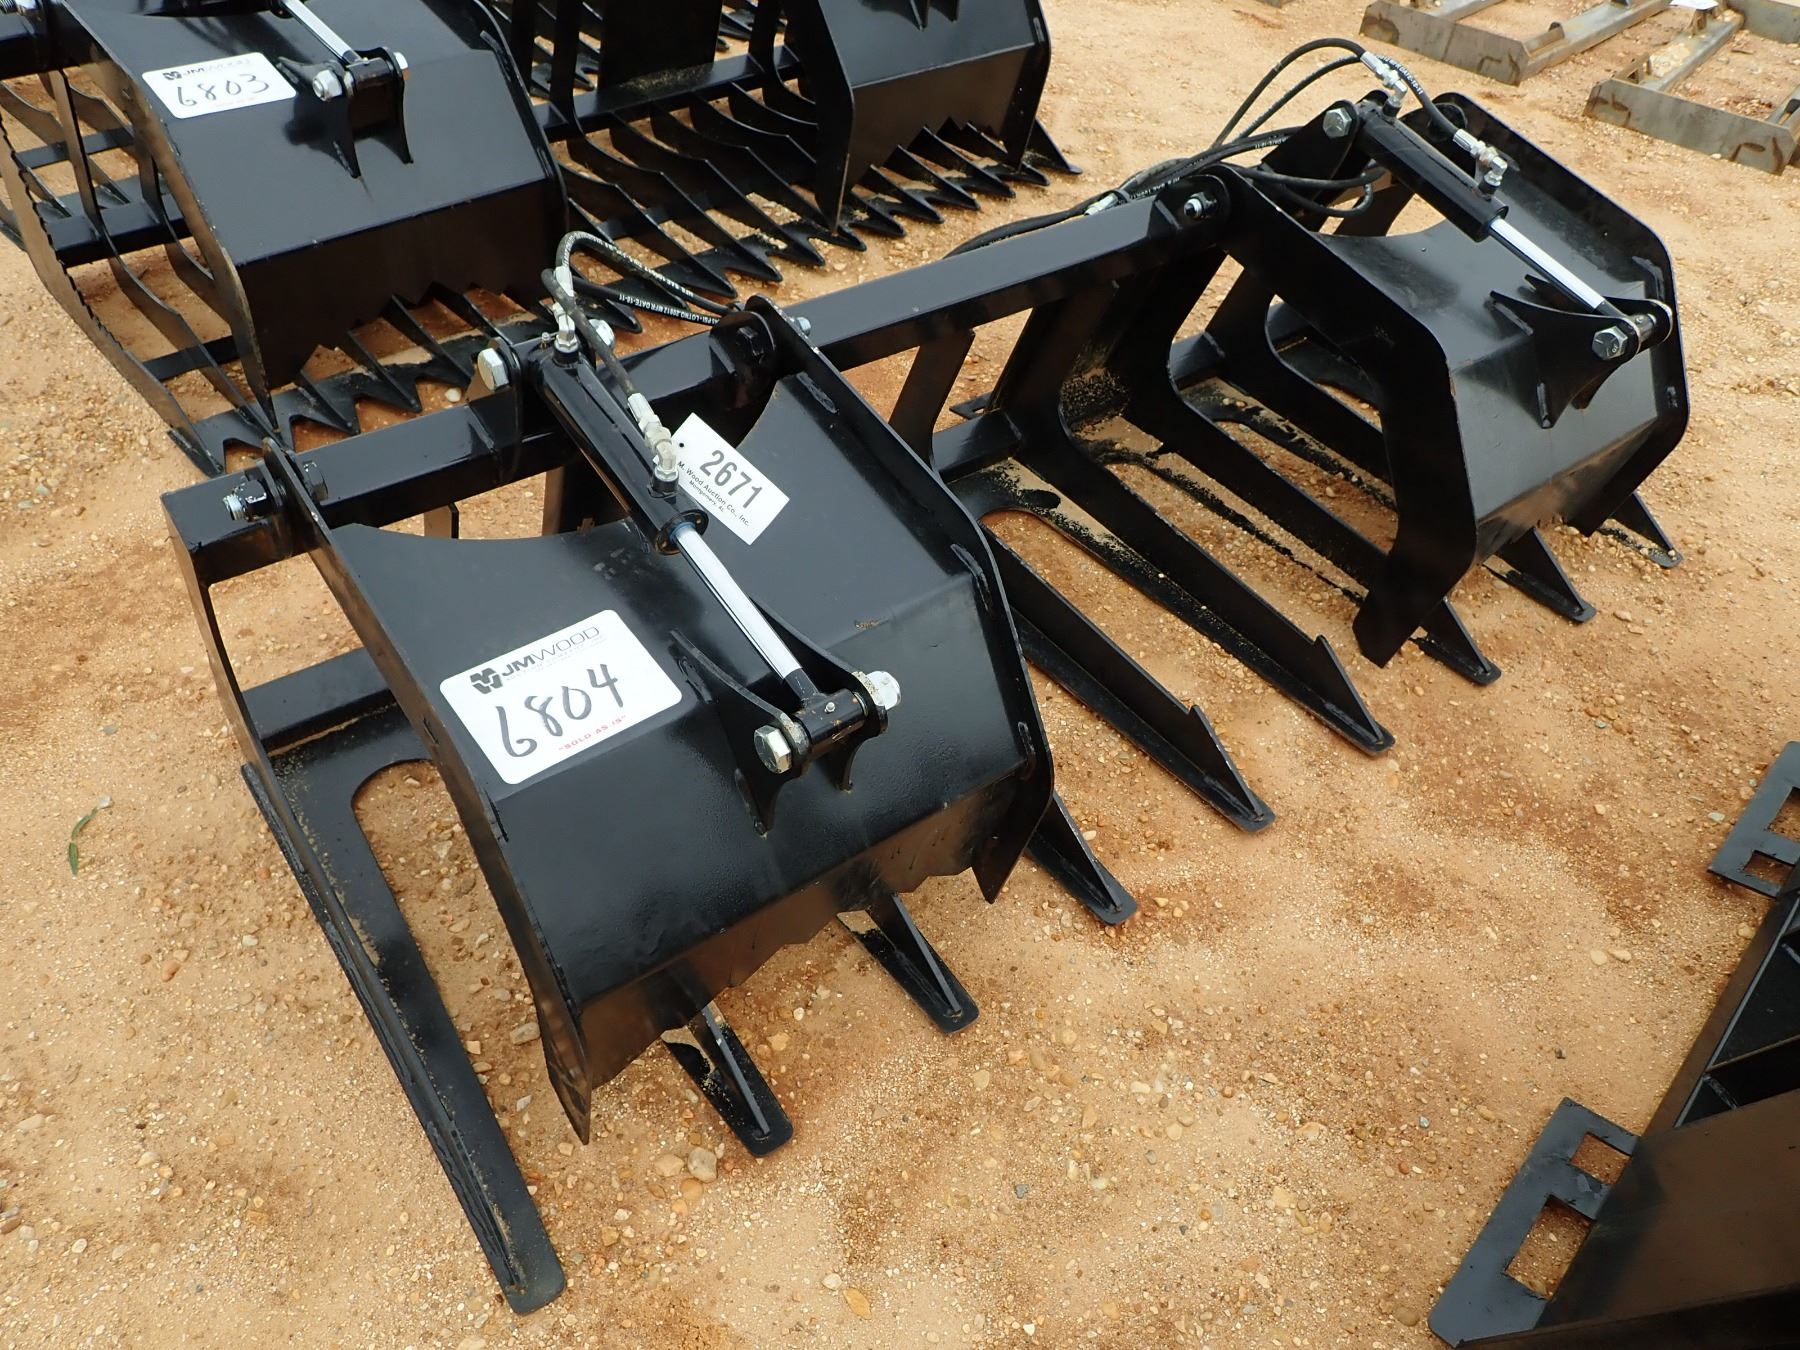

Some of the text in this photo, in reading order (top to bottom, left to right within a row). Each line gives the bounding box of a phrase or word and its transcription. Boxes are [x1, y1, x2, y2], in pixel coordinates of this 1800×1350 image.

[177, 73, 270, 107] 6803
[686, 467, 704, 486] Wood
[703, 484, 726, 505] Auction
[738, 514, 751, 527] Inc.
[699, 449, 763, 509] 2671
[494, 663, 624, 758] 6804
[595, 724, 609, 735] AS
